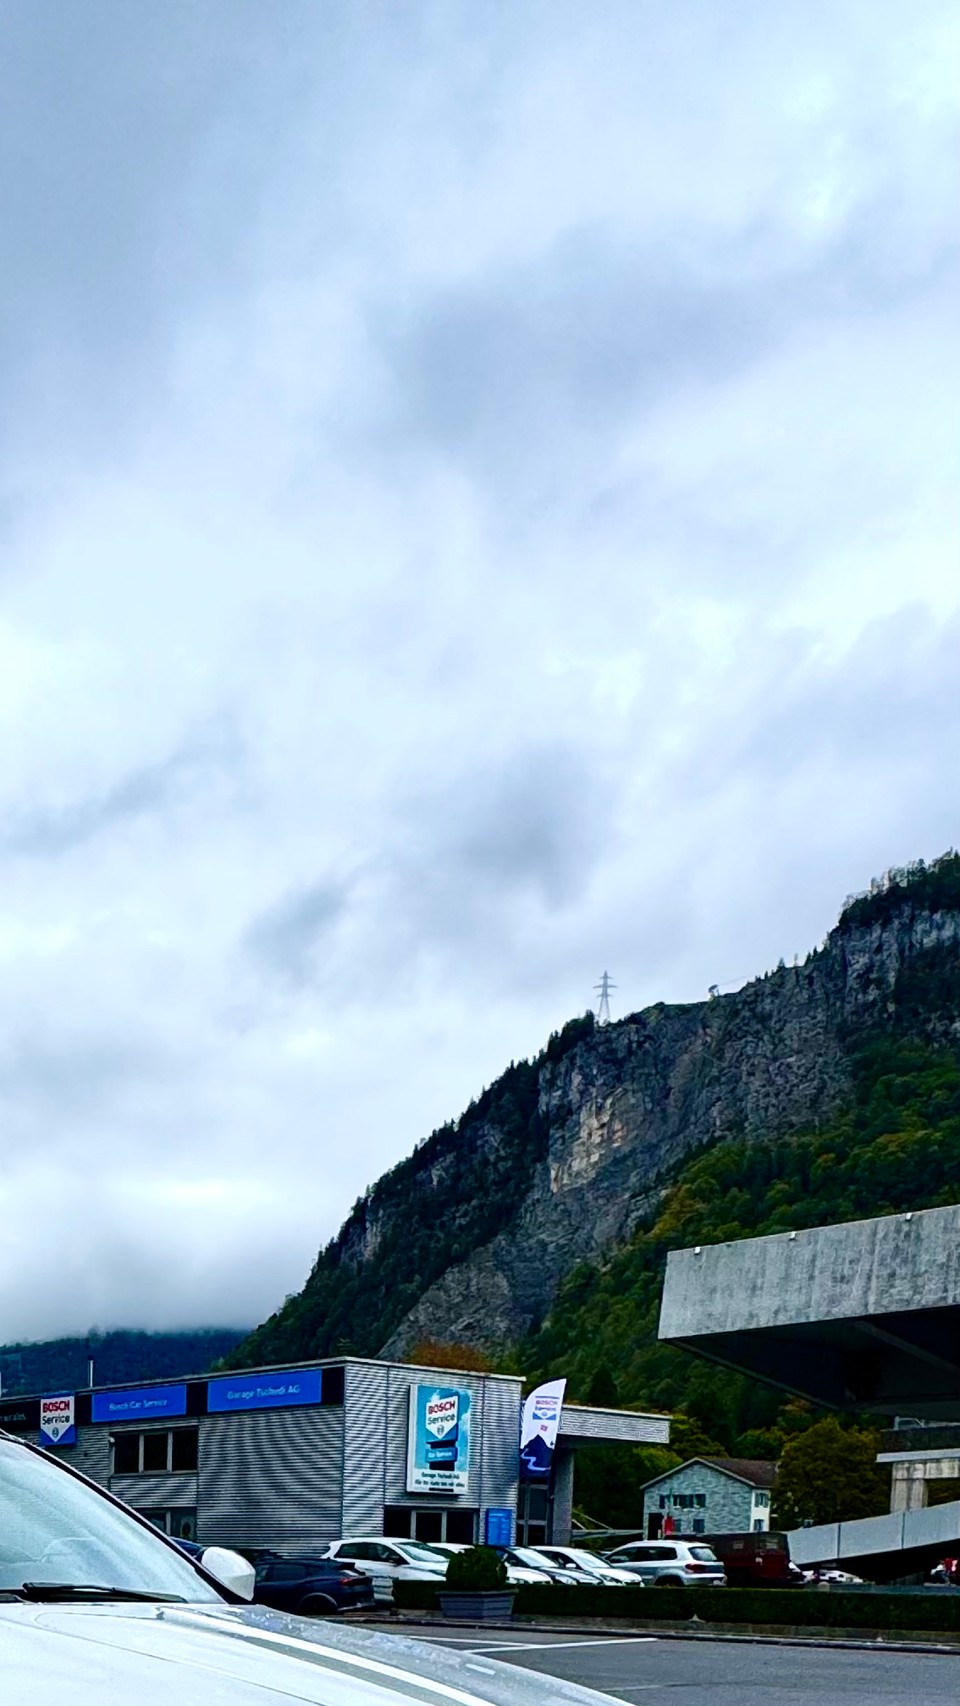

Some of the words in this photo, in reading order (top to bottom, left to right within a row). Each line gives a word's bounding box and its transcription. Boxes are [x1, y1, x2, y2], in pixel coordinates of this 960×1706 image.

[287, 1384, 300, 1394] AG
[42, 1400, 70, 1413] BOSCH
[428, 1400, 456, 1415] BOSCH
[42, 1414, 71, 1426] Service
[428, 1413, 456, 1425] Service
